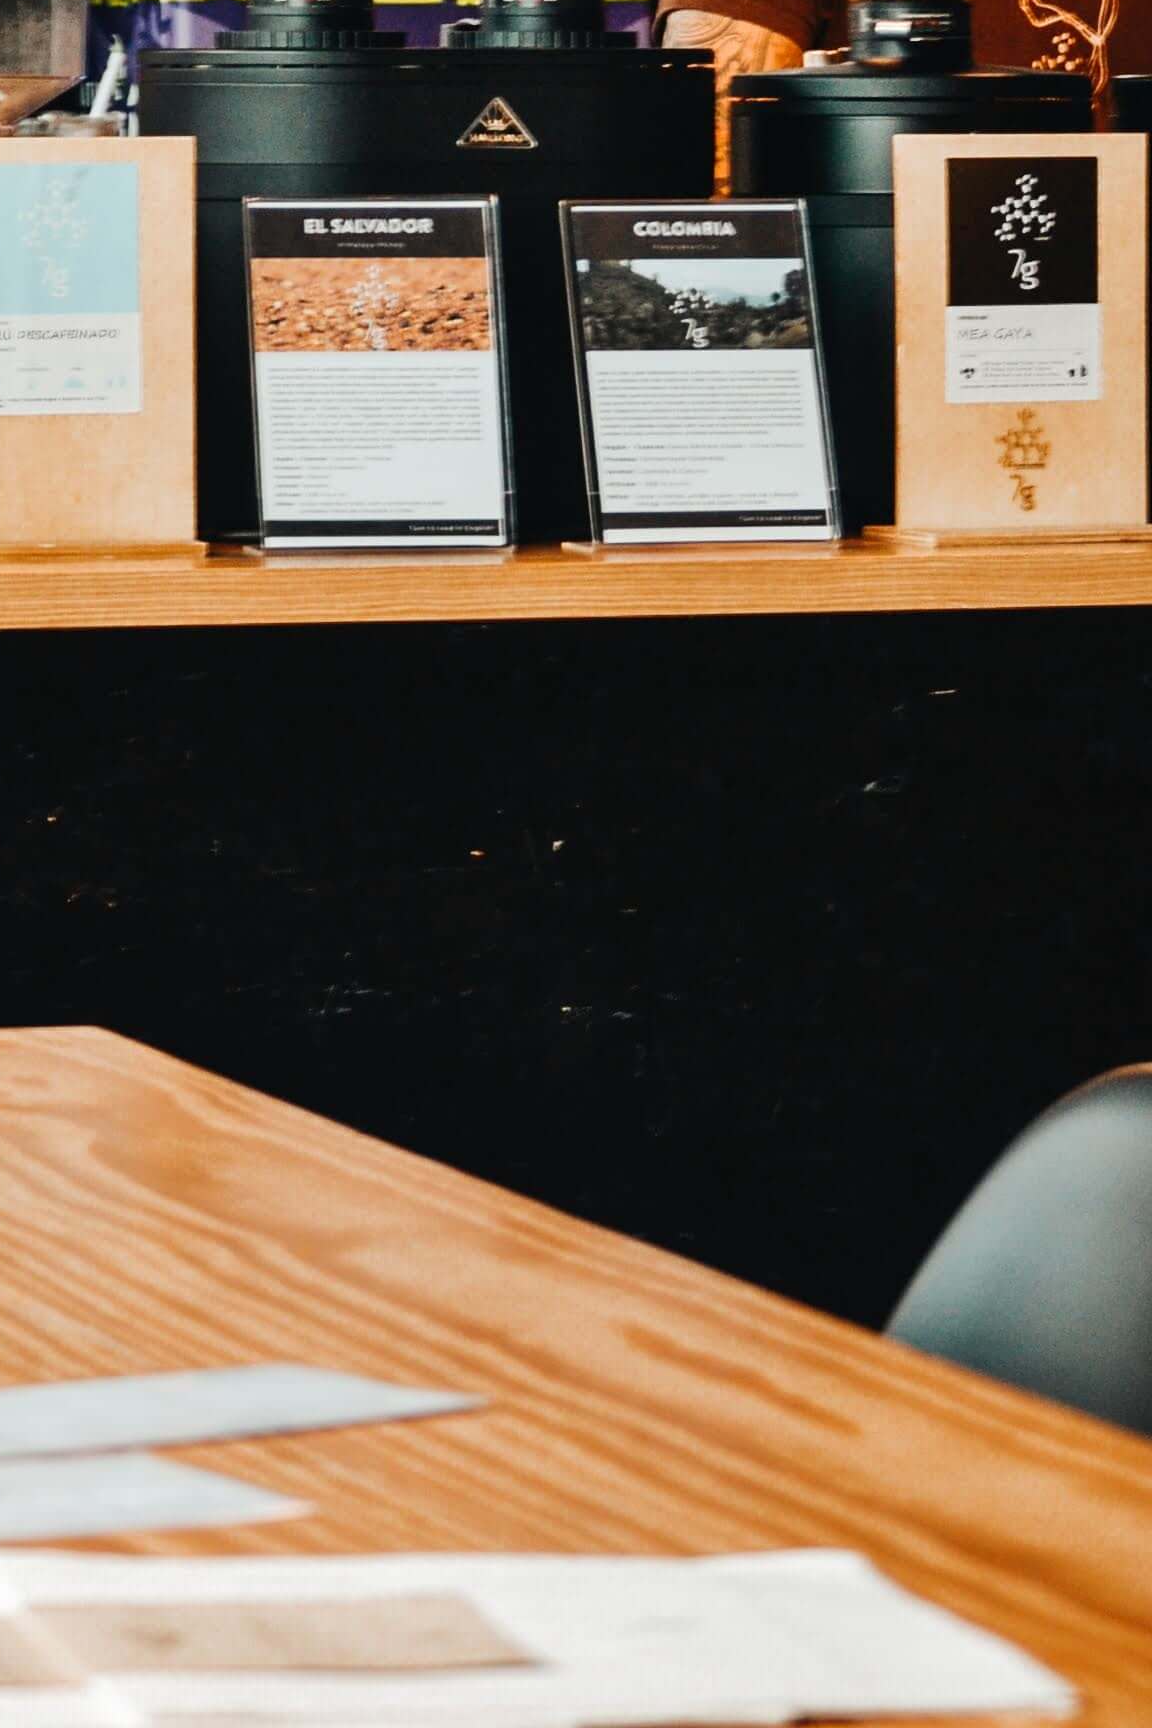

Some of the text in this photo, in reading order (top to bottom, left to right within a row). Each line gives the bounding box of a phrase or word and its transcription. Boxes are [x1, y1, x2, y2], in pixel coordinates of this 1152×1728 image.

[303, 218, 435, 234] EL SALVADOR
[632, 220, 736, 237] COLOMBIA
[1006, 248, 1040, 290] 7g
[680, 317, 710, 348] 7g
